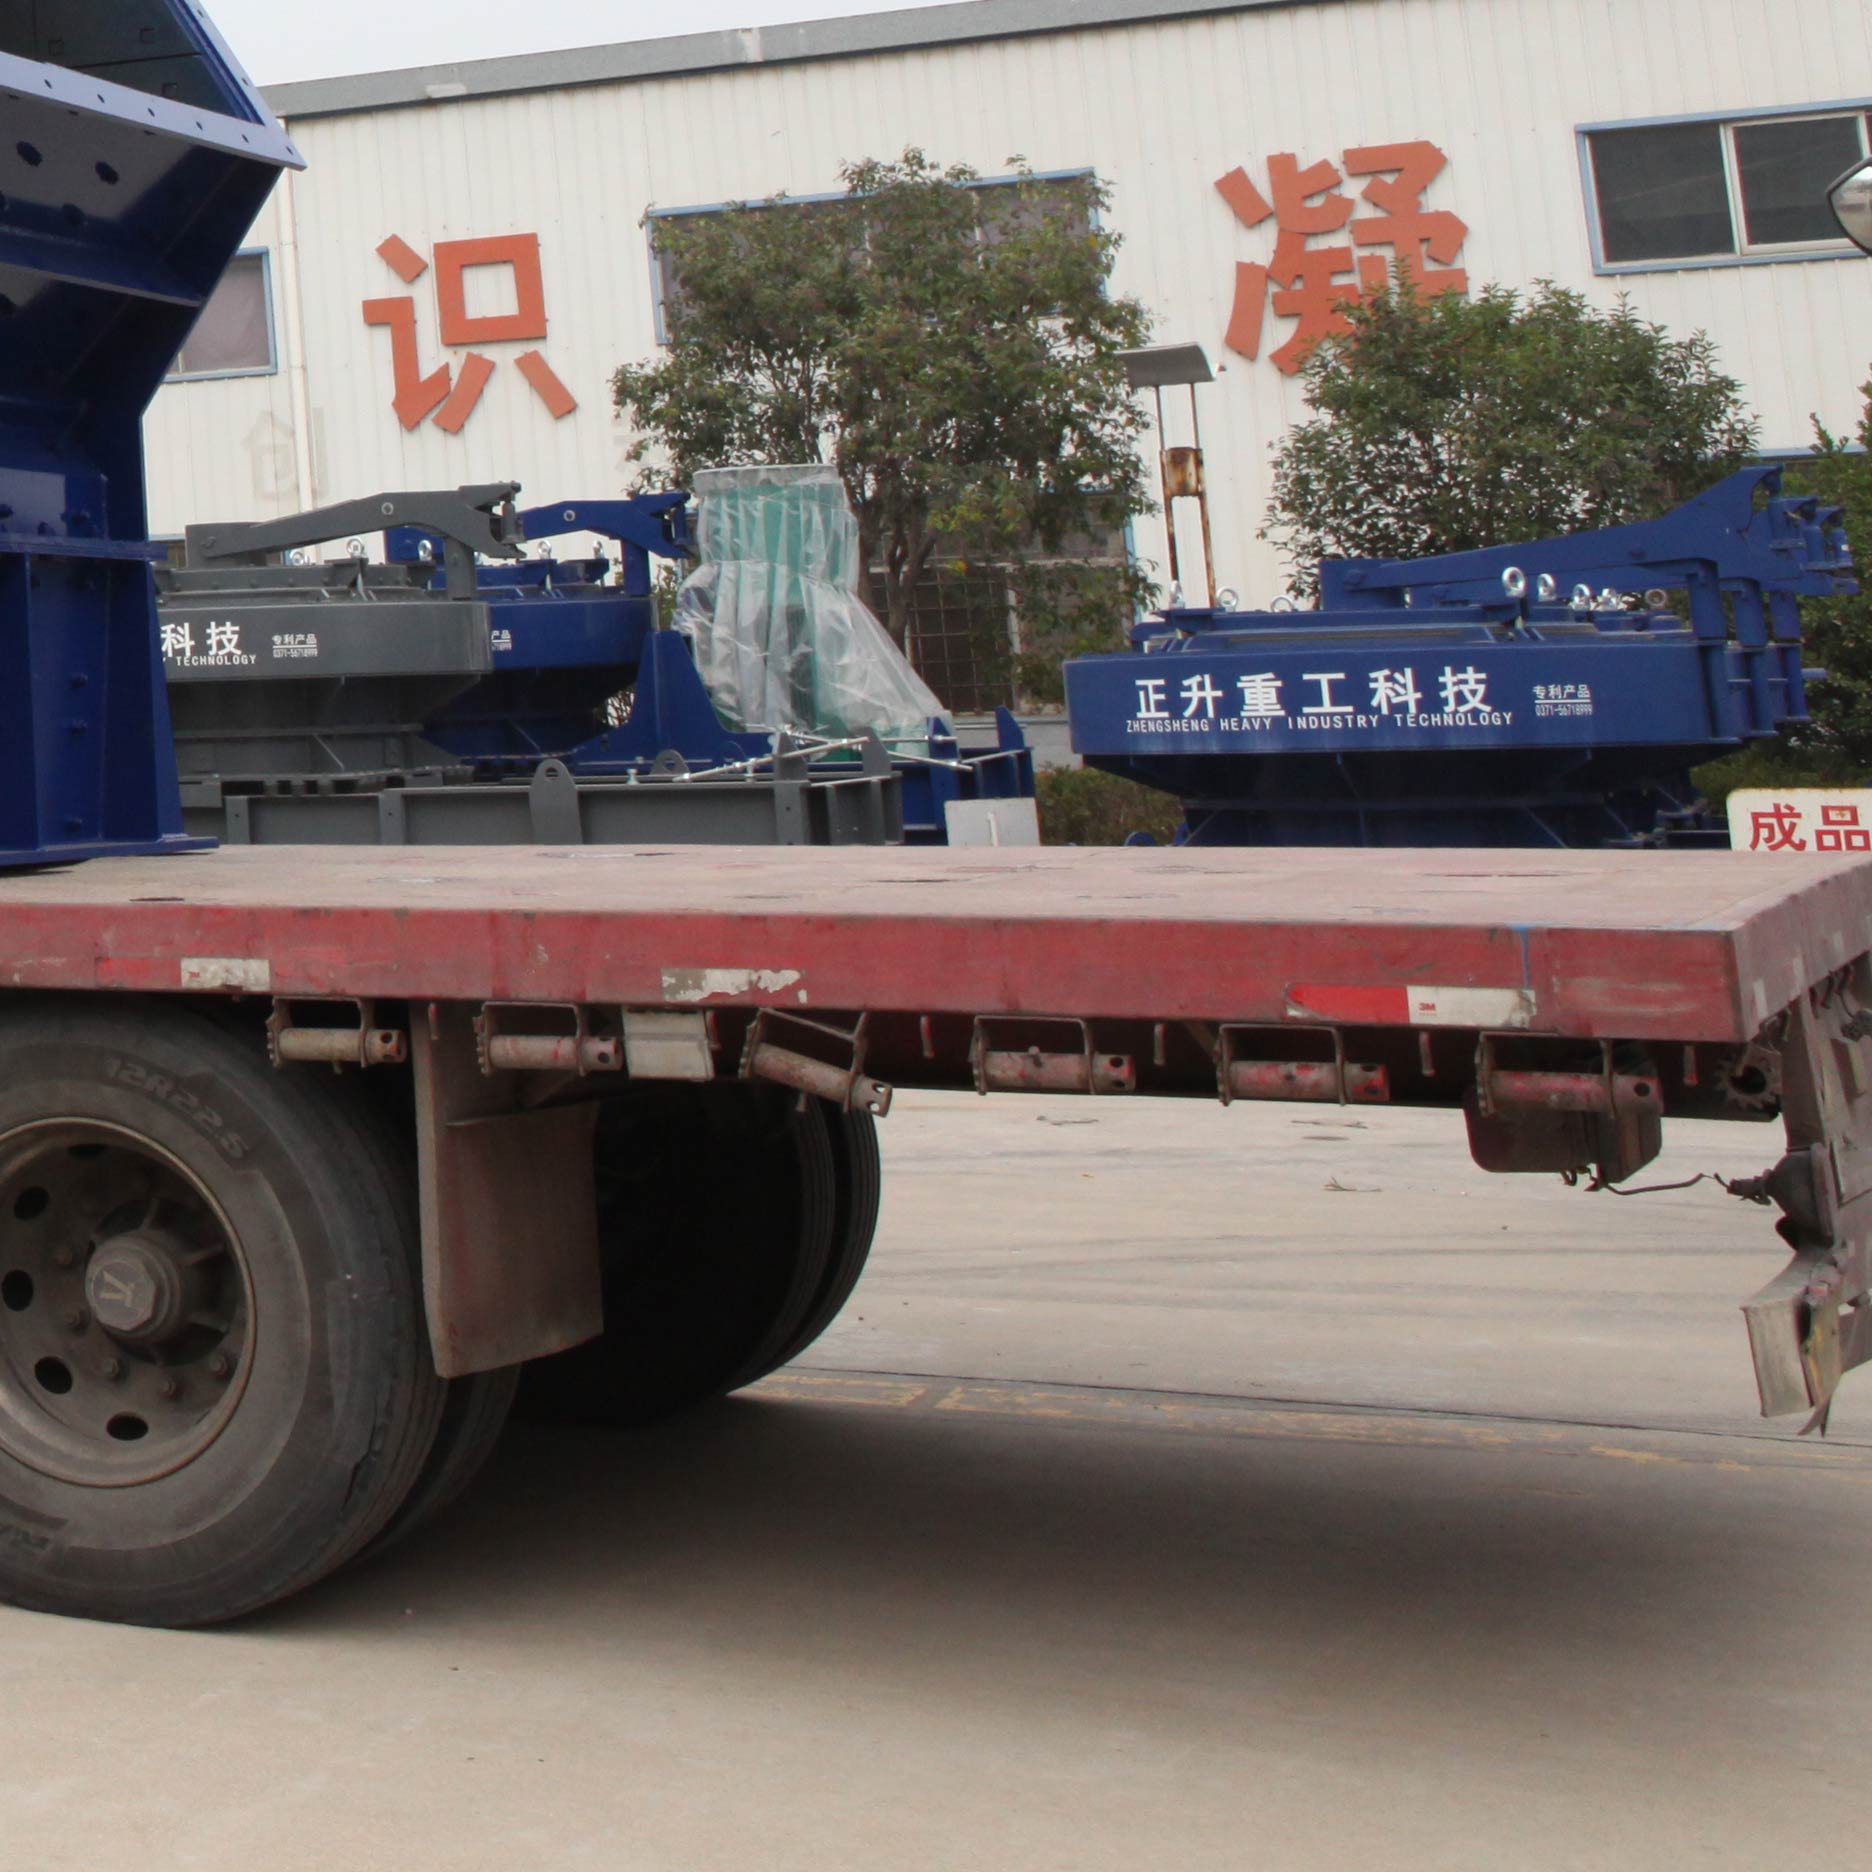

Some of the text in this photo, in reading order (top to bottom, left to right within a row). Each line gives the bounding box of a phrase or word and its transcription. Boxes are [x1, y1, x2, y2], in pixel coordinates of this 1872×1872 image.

[361, 230, 579, 434] 识
[160, 621, 243, 657] 科技
[175, 654, 257, 666] TECHNOLOGY
[1134, 665, 1493, 719] 正升重工科技
[1532, 684, 1591, 699] 专利产品
[1126, 710, 1514, 733] ZHENGSHENG HEAVY INDUSTRY TECHNOLOGY
[1749, 802, 1872, 851] 成品
[1418, 1002, 1436, 1011] 3M
